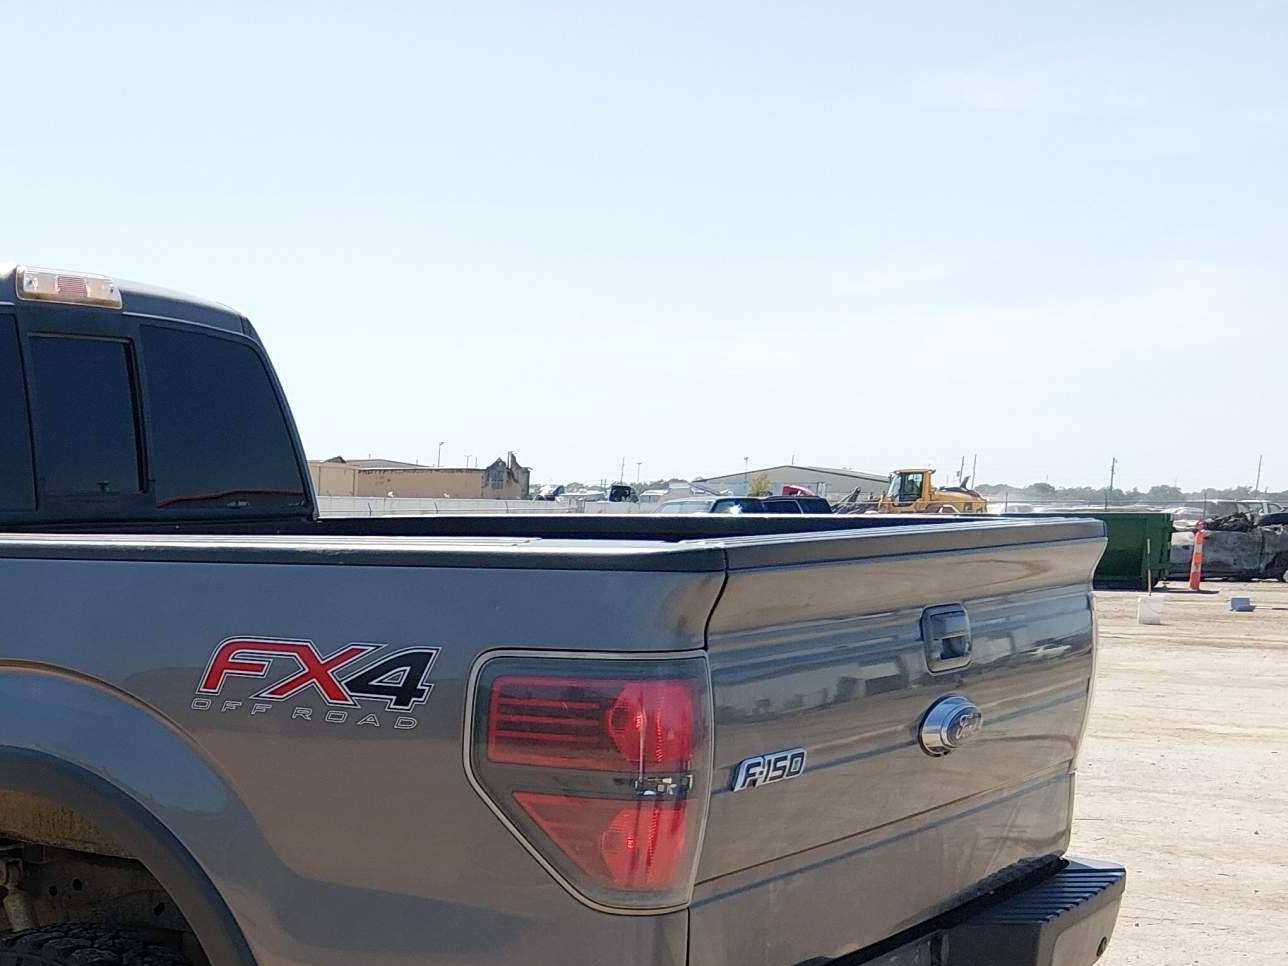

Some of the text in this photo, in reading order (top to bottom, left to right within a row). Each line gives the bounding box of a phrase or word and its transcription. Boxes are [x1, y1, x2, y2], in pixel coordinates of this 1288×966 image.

[196, 635, 442, 713] FX4
[191, 698, 418, 730] OFF ROAD
[735, 749, 806, 790] F-150
